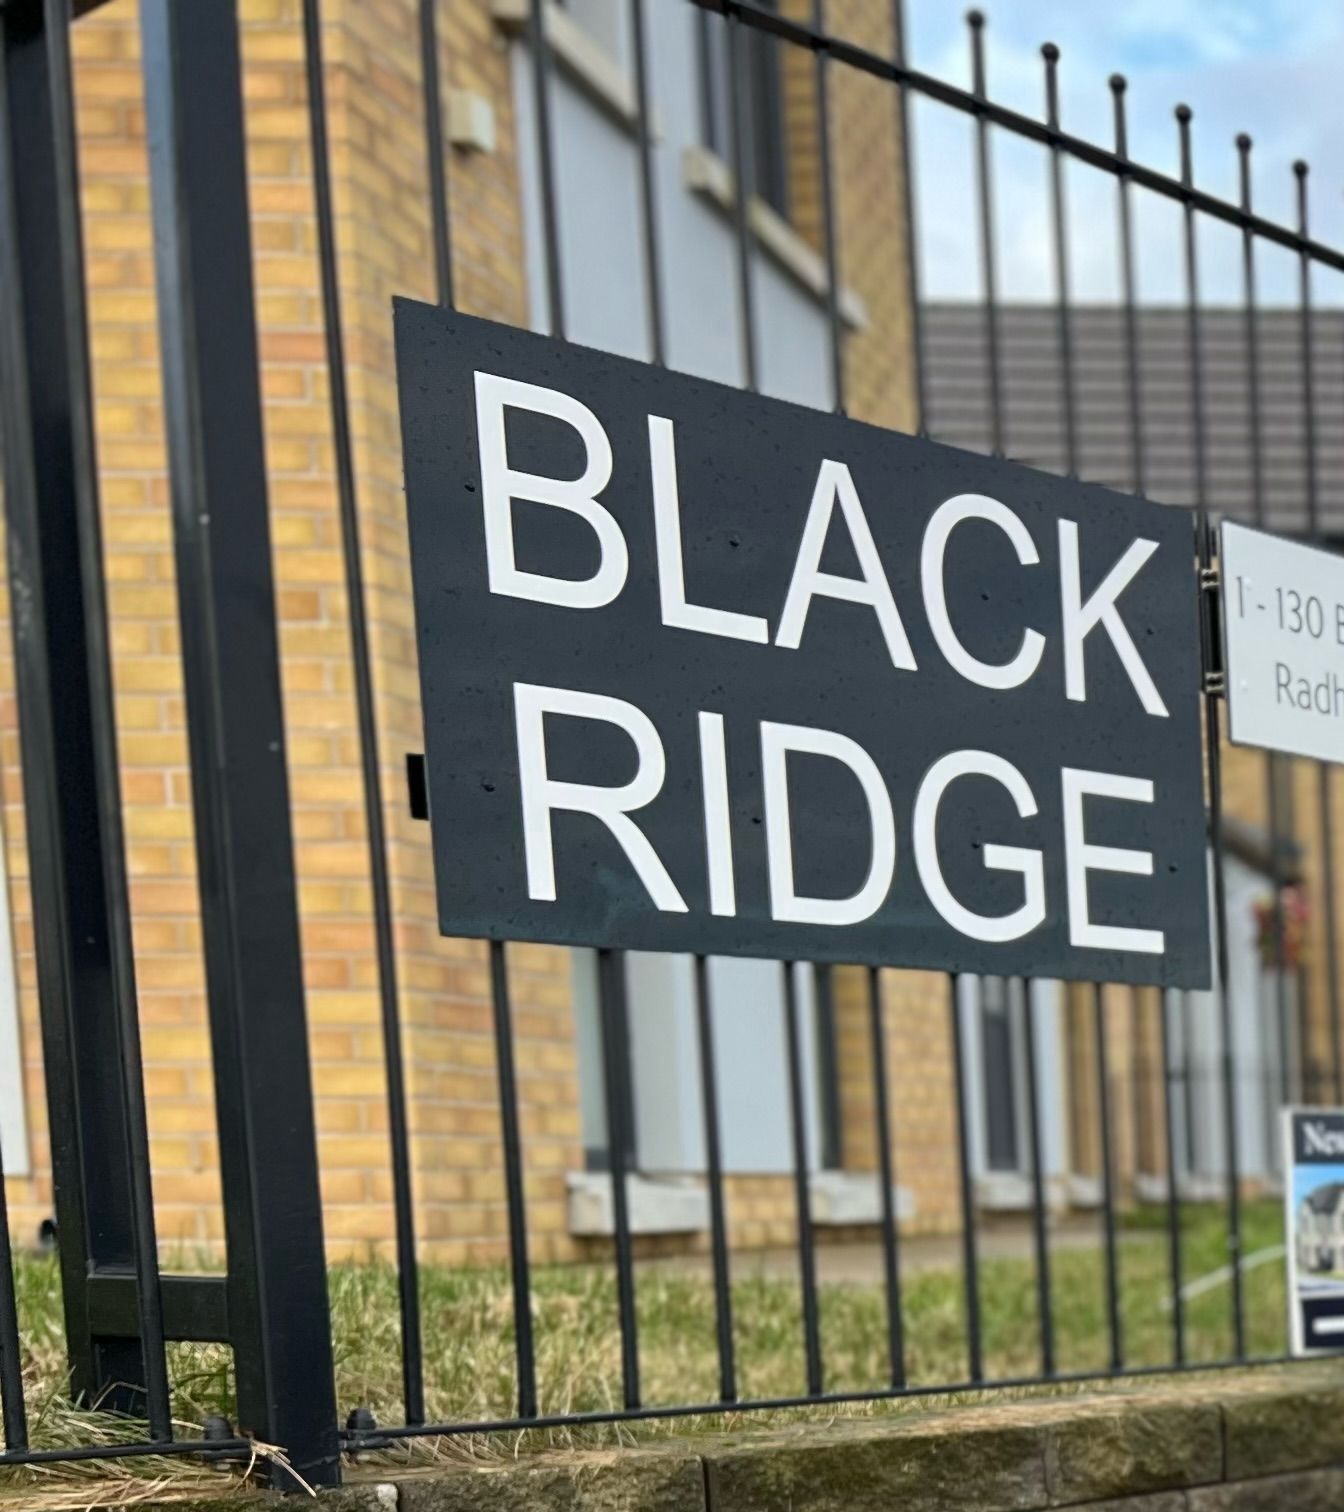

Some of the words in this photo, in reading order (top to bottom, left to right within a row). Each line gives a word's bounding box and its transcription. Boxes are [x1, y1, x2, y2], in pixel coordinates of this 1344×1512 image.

[473, 370, 1170, 718] BLACK
[1235, 575, 1245, 618] 1
[1275, 586, 1324, 639] 130
[513, 682, 1166, 955] RIDGE
